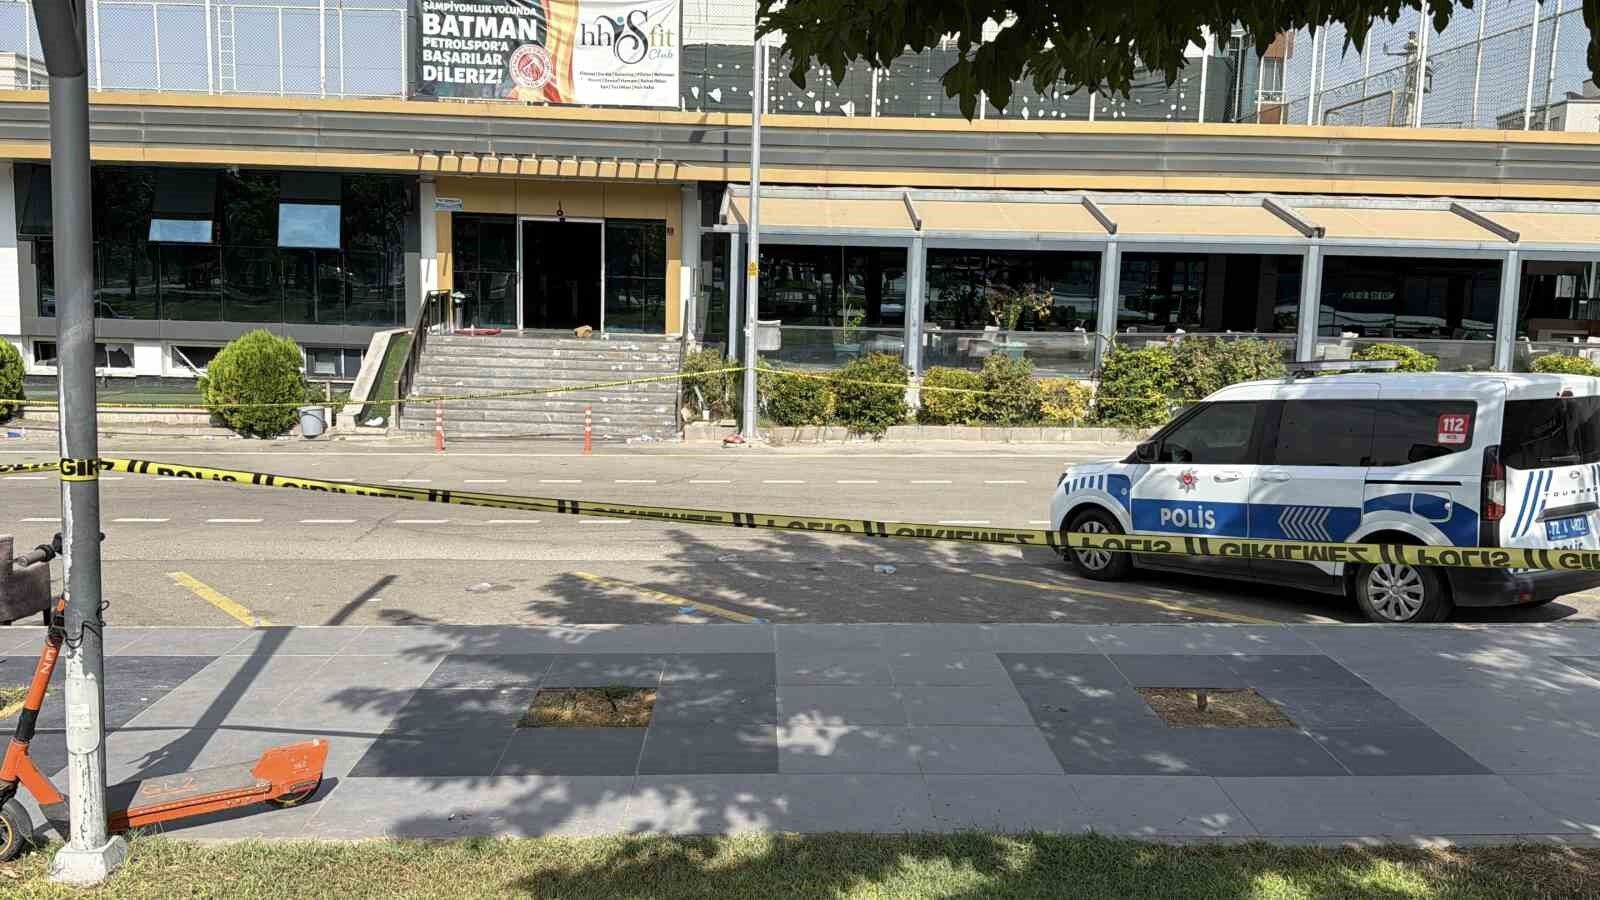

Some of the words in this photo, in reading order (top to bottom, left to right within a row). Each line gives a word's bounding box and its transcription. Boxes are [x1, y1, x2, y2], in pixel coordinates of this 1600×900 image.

[493, 5, 537, 16] YOLUNDA
[422, 13, 537, 40] BATMAN
[422, 36, 509, 52] PETROLSPOR'A
[422, 49, 503, 66] BAŞARILAR
[1443, 417, 1465, 432] 112
[1160, 505, 1216, 529] POLİS
